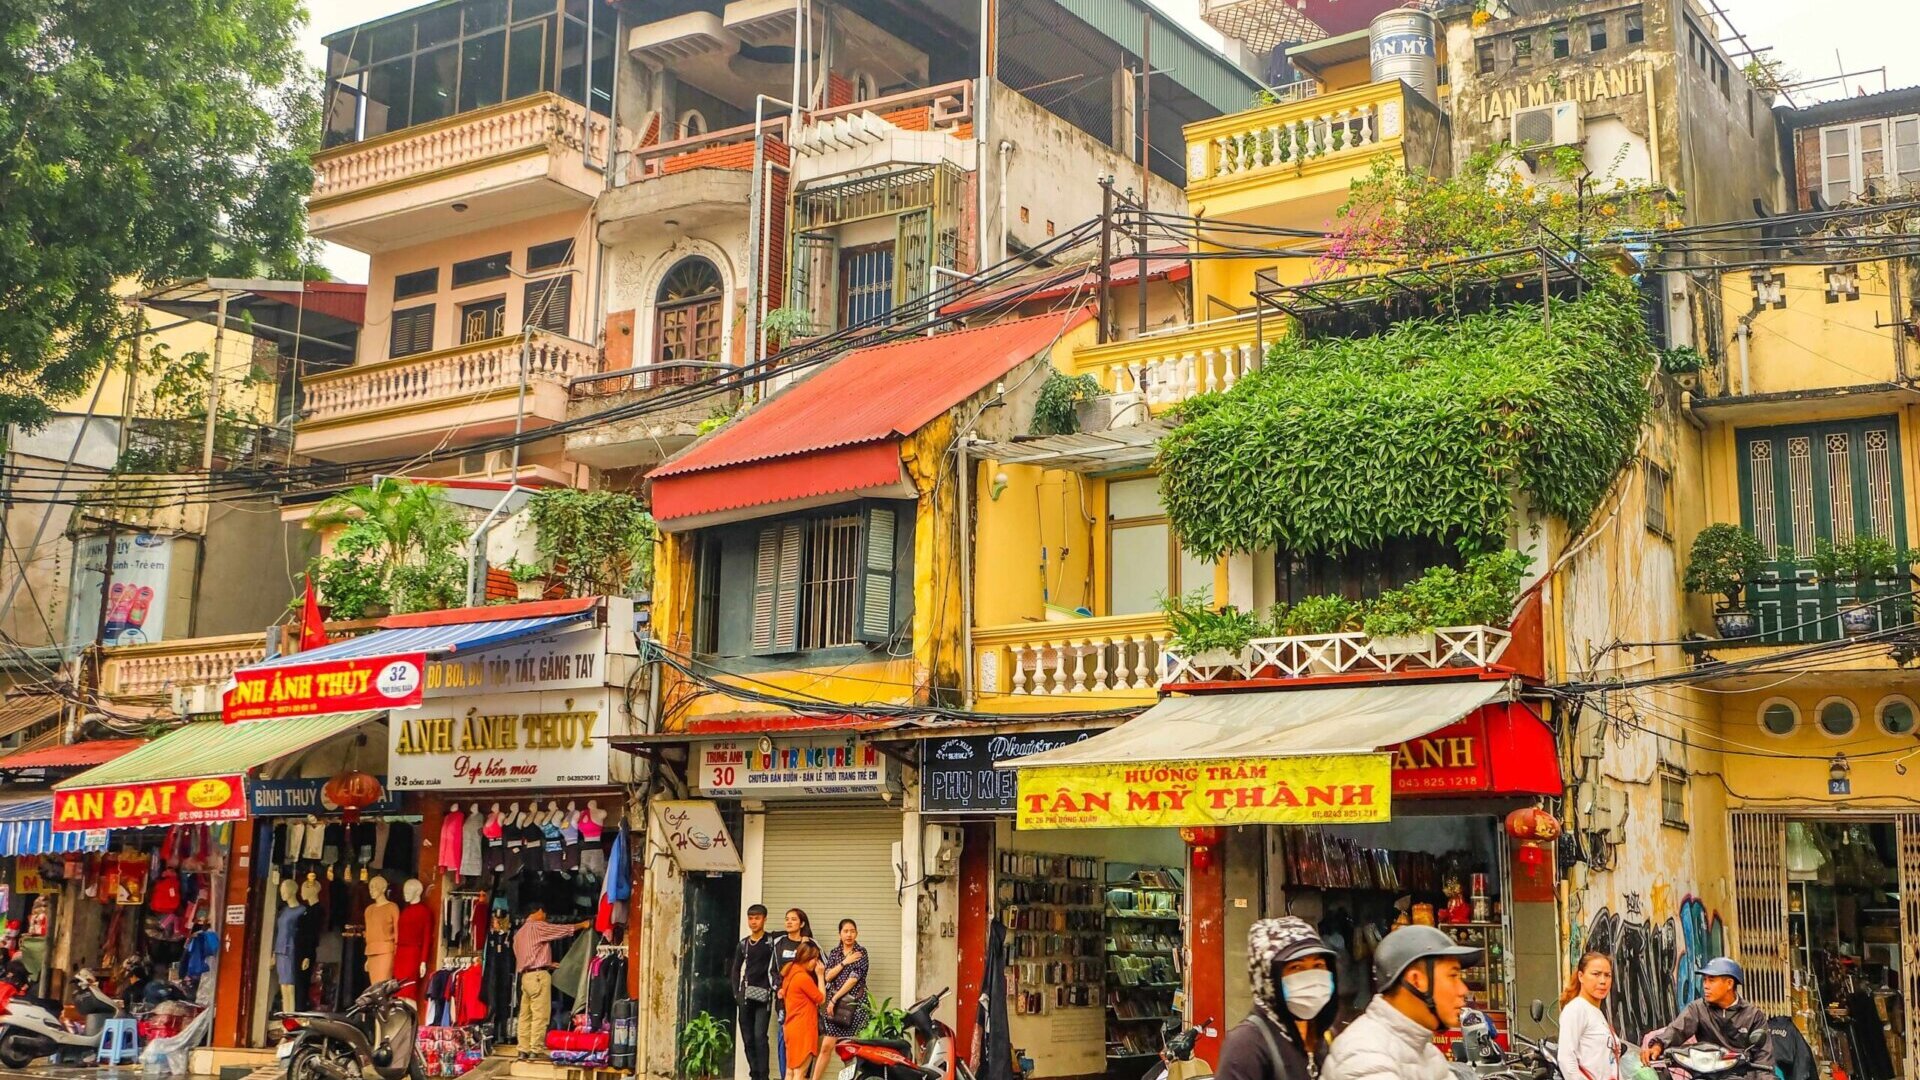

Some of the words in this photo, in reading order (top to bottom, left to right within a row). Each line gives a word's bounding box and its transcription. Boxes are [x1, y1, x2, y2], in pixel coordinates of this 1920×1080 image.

[1401, 37, 1427, 55] MỸ
[389, 665, 407, 681] 32
[539, 651, 571, 681] GĂNG
[575, 653, 595, 678] TAY
[269, 671, 313, 702] ÁNH
[316, 662, 373, 698] THỦY
[395, 717, 455, 754] ANH
[458, 706, 519, 751] ÁNH
[522, 698, 599, 749] THỦY
[706, 751, 728, 763] TRUNG
[729, 751, 743, 763] ANH
[781, 747, 824, 769] TRANG
[395, 776, 407, 786] 32
[453, 755, 483, 784] Đẹp
[485, 758, 507, 776] bốn
[510, 760, 538, 775] mùa
[712, 767, 735, 786] 30
[748, 772, 769, 784] CHUYÊN
[770, 772, 782, 783] BÁN
[783, 771, 798, 783] BUÔN
[803, 771, 814, 782] BÁN
[838, 770, 856, 781] TRANG
[869, 771, 878, 780] EM
[1125, 764, 1199, 784] HƯƠNG
[1205, 759, 1267, 780] TRẦM
[255, 784, 283, 807] BÌNH
[932, 771, 973, 806] PHỤ
[1024, 787, 1112, 813] TÂN
[1127, 784, 1193, 811] MỸ
[1205, 780, 1375, 809] THÀNH
[1832, 780, 1846, 792] 24
[60, 792, 104, 822] AN
[113, 785, 176, 824] ĐẠT
[664, 807, 691, 830] Cafe
